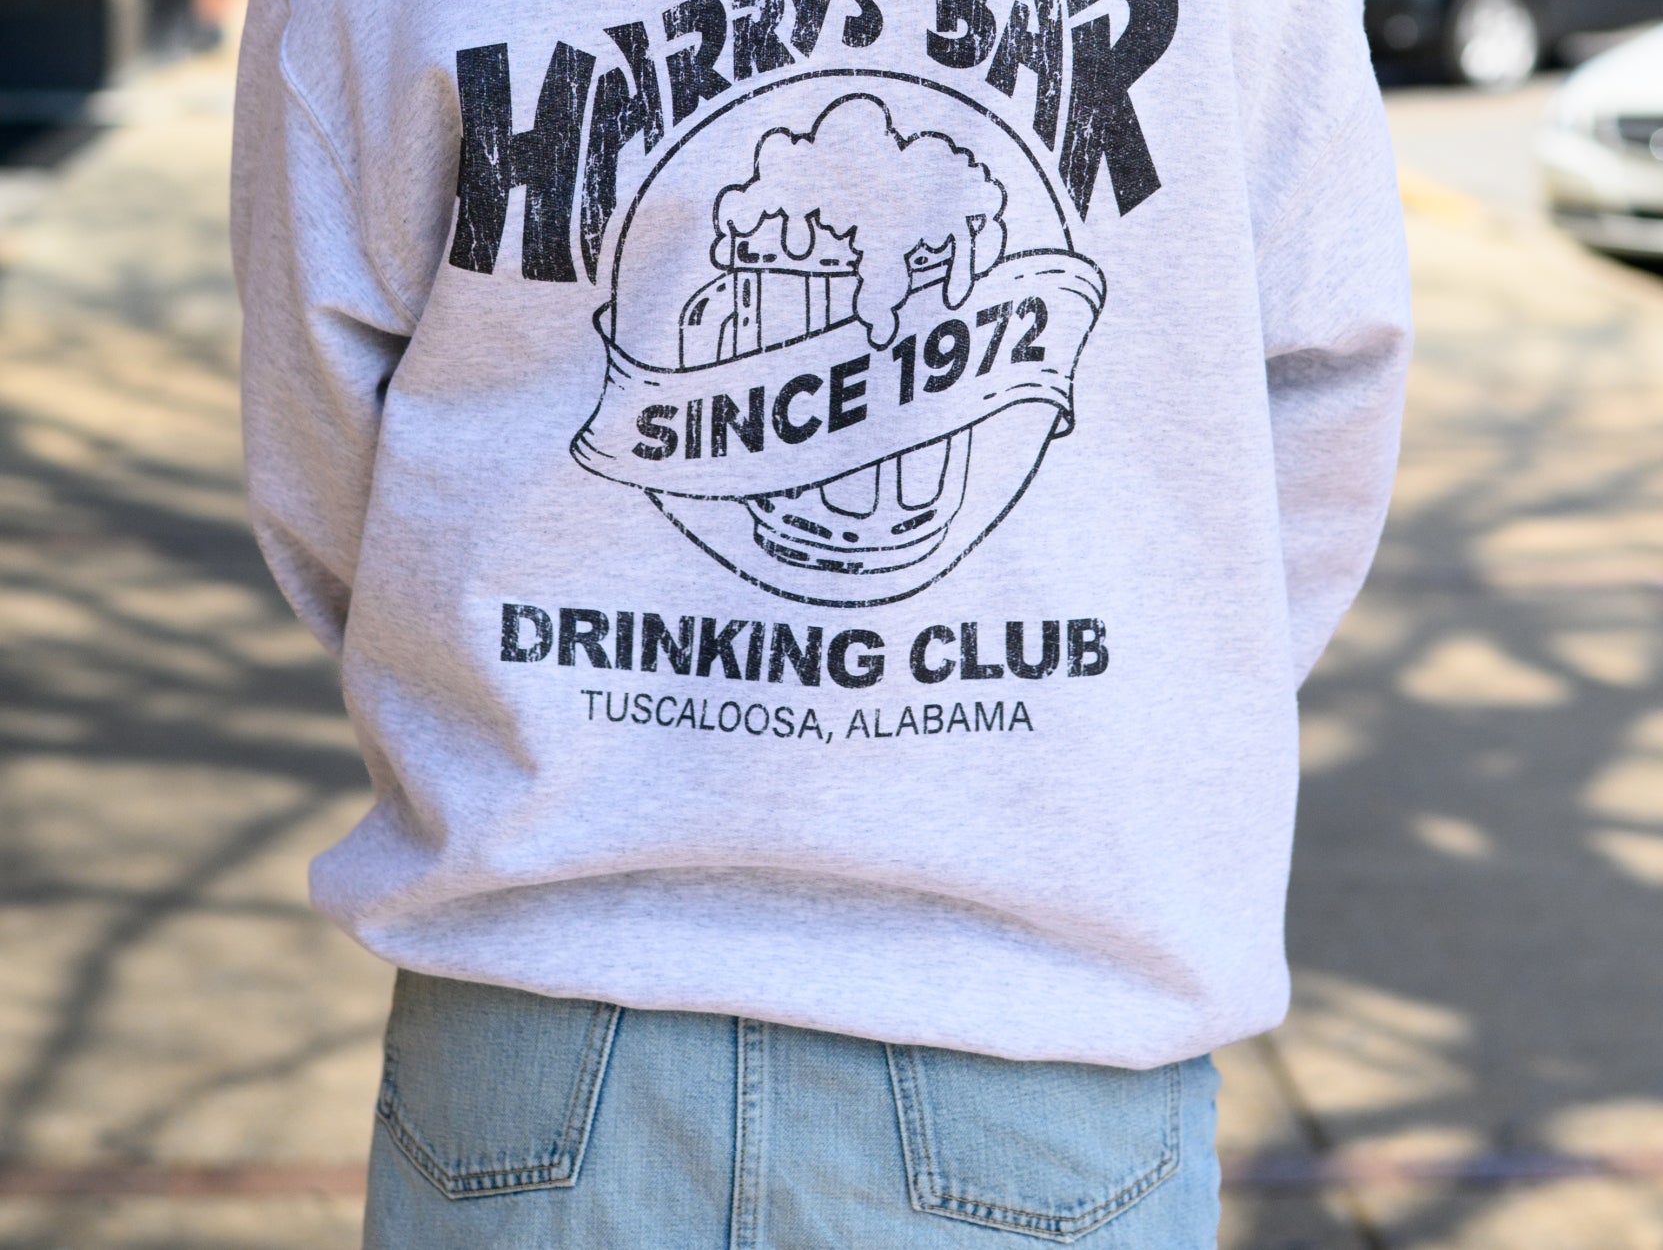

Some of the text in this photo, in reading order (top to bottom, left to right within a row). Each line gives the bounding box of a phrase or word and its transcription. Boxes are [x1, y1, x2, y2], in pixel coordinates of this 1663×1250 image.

[631, 296, 1048, 461] SINCE 1972
[500, 603, 1109, 689] DRINKING CLUB
[581, 690, 1034, 744] TUSCALOOSA, ALABAMA
